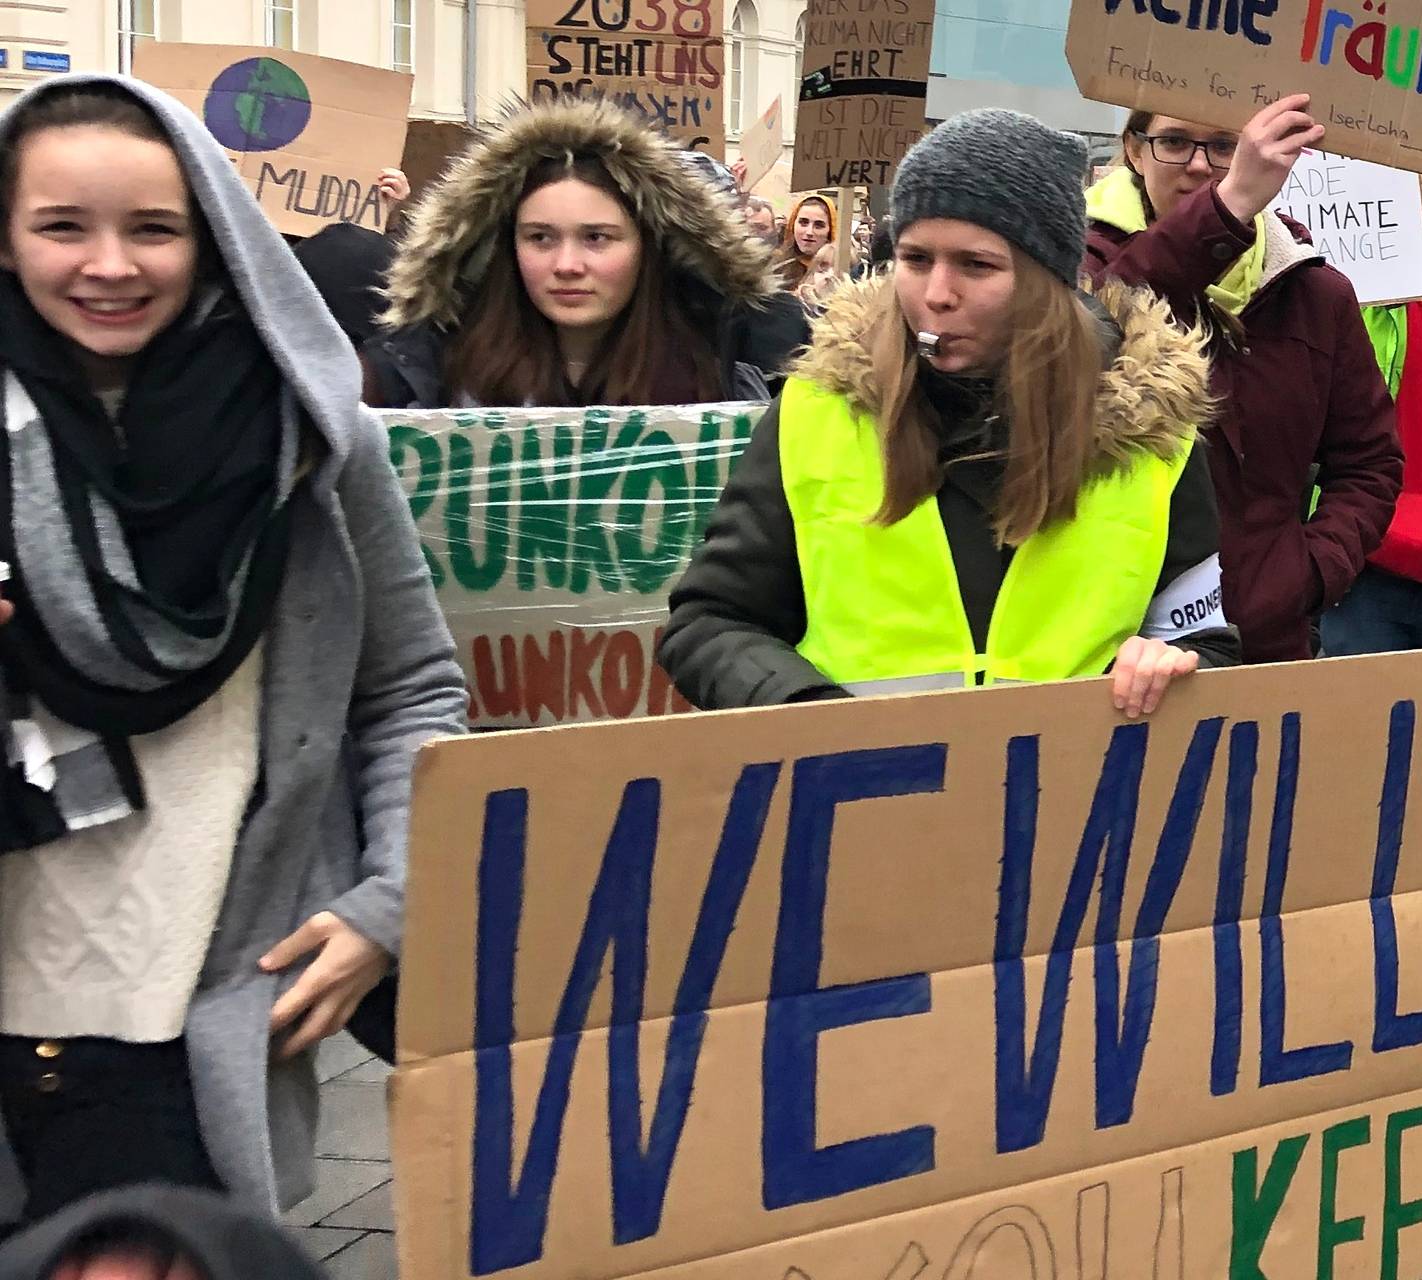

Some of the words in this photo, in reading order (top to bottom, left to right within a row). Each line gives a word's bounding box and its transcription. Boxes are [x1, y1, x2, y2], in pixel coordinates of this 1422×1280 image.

[808, 19, 861, 46] KLIMA
[868, 19, 932, 48] NICHT
[547, 35, 652, 77] STEHT
[654, 38, 725, 90] UNS
[832, 49, 903, 79] EHRT
[1107, 46, 1189, 90] Fridays
[817, 98, 850, 126] IST
[861, 98, 907, 127] DIE
[802, 128, 848, 161] WELT
[825, 160, 890, 186] WERT
[1280, 165, 1347, 201] ADE
[256, 161, 382, 227] MUDDA
[1274, 199, 1399, 232] IMATE
[1170, 585, 1222, 629] ORDNE
[470, 742, 949, 1277] WE
